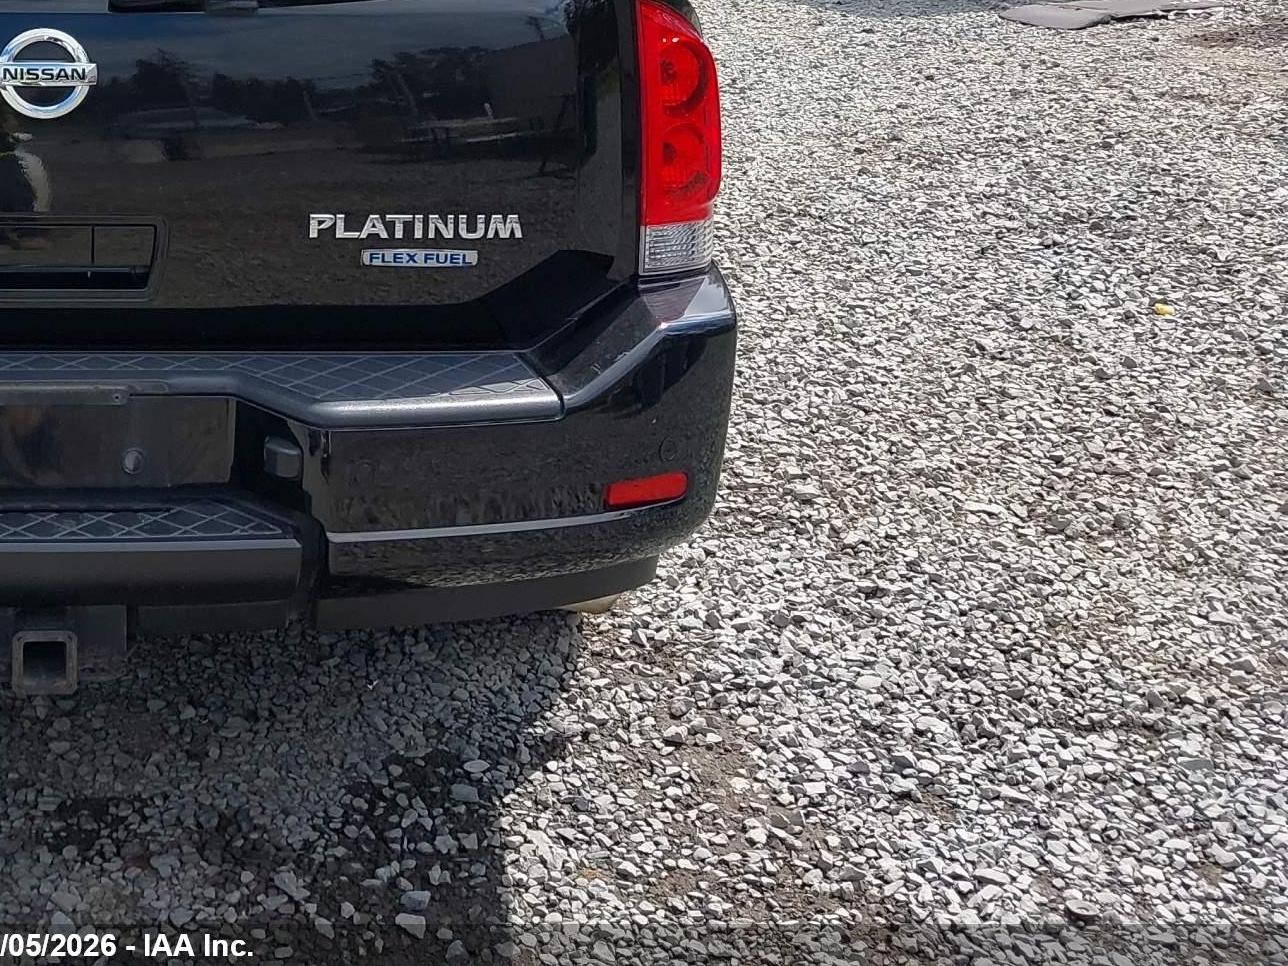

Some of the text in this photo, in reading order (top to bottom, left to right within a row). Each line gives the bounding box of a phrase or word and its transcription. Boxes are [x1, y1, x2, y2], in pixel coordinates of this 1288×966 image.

[2, 67, 87, 82] NISSAN
[309, 213, 523, 240] PLATINUM
[369, 253, 473, 265] FLEX FUEL
